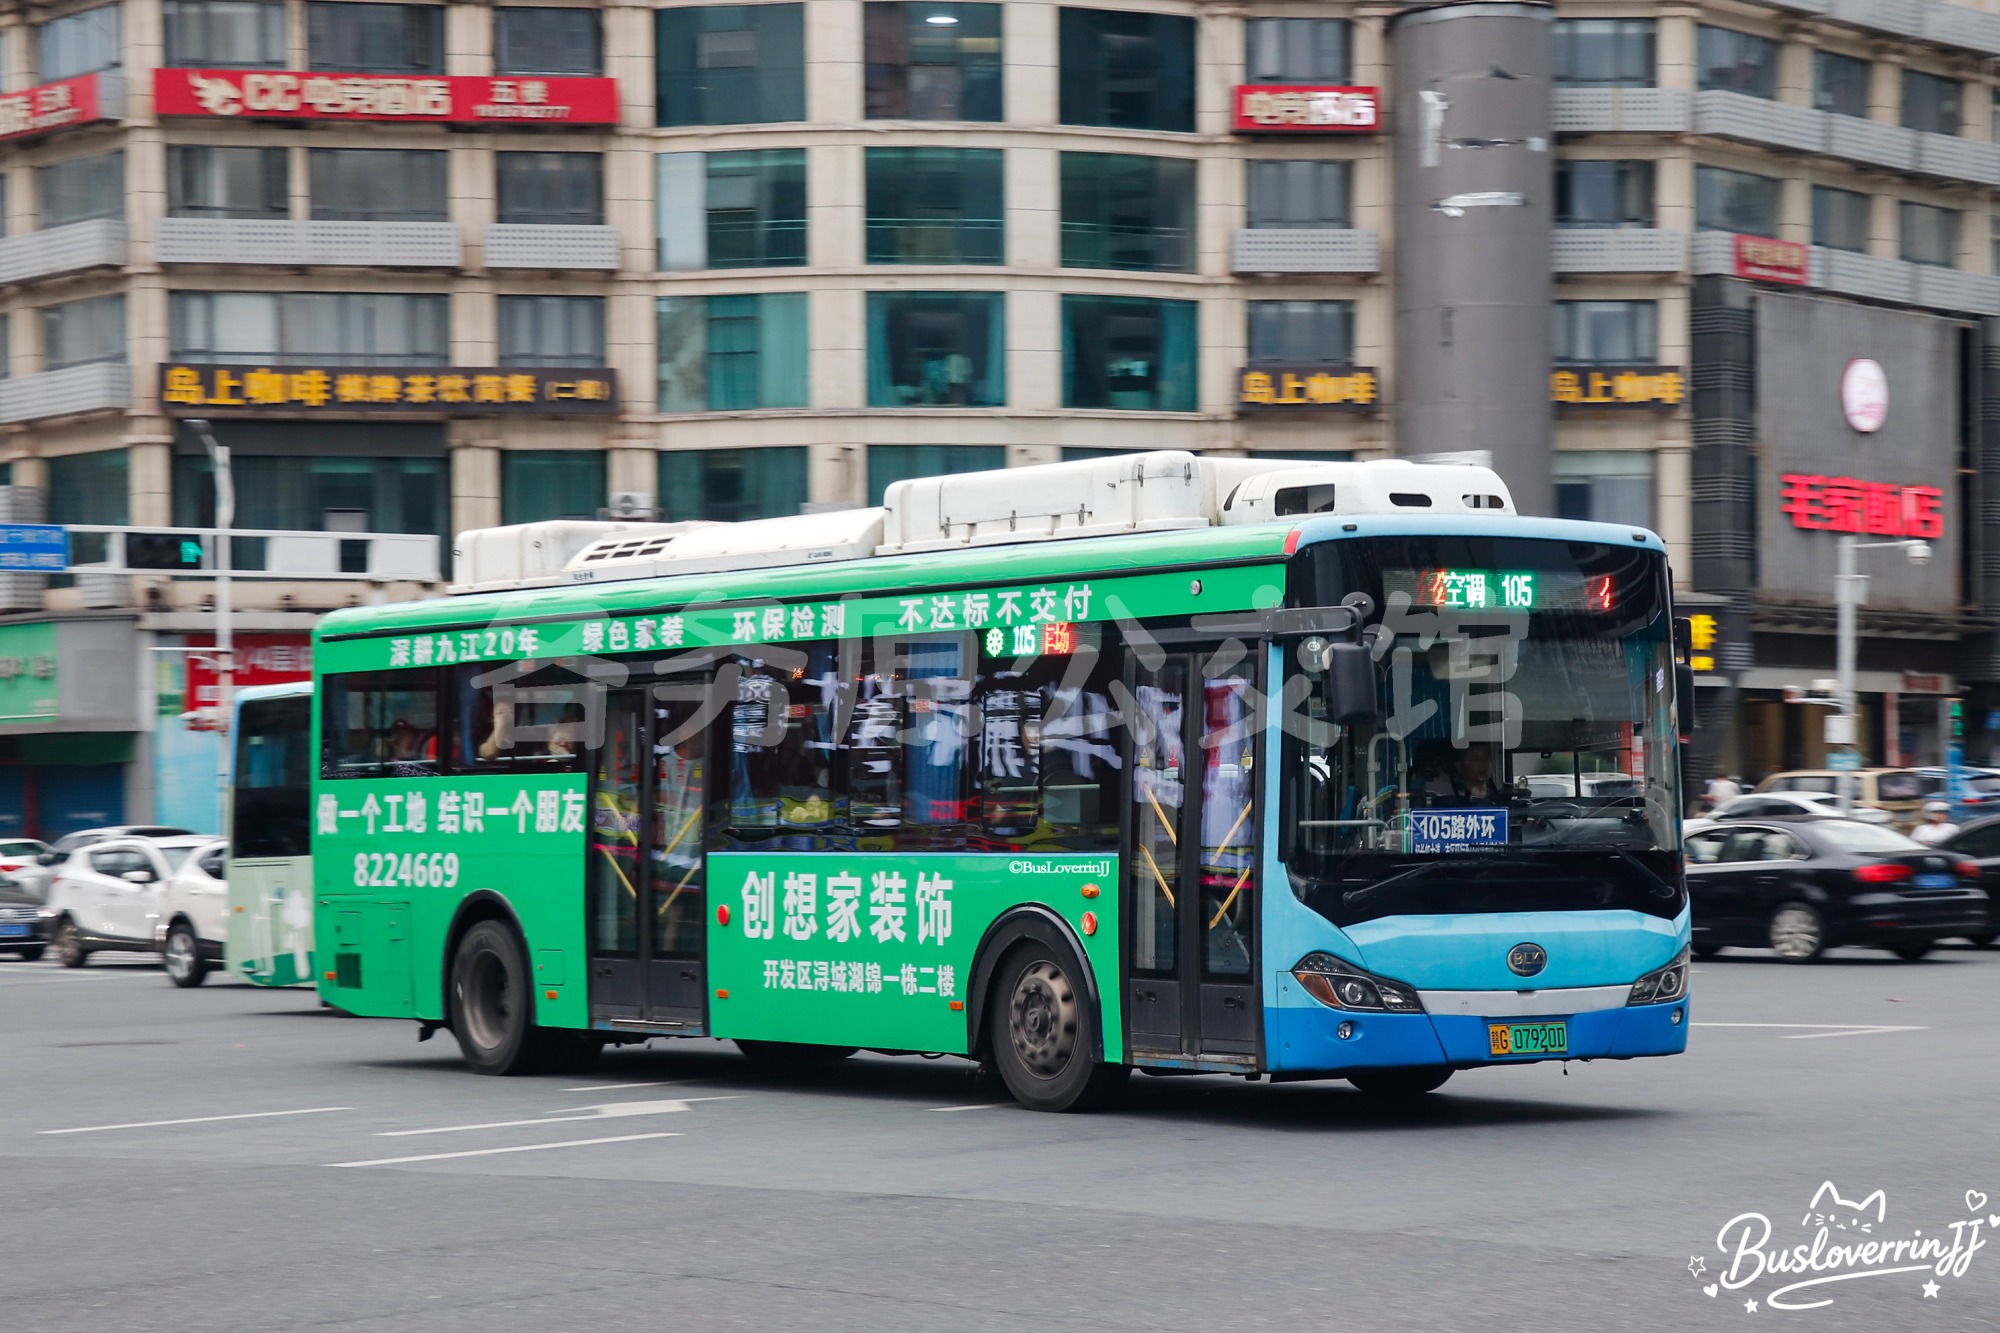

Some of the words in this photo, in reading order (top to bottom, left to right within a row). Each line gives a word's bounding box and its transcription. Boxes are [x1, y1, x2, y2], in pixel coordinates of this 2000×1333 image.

[1443, 571, 1486, 608] 空调
[1501, 574, 1533, 607] 105
[390, 628, 539, 667] 深耕九江20年
[582, 615, 684, 653] 绿色家装
[732, 603, 846, 642] 环保检测
[898, 585, 1093, 632] 不达标不交付
[1012, 624, 1037, 655] 105
[317, 791, 427, 835] 做一个工地
[437, 788, 586, 834] 结识一个朋友
[1420, 814, 1496, 840] 105路外环
[353, 852, 460, 888] 8224669
[741, 871, 954, 946] 创想家装饰
[763, 959, 955, 997] 开发区浔城湖锦一栋二楼
